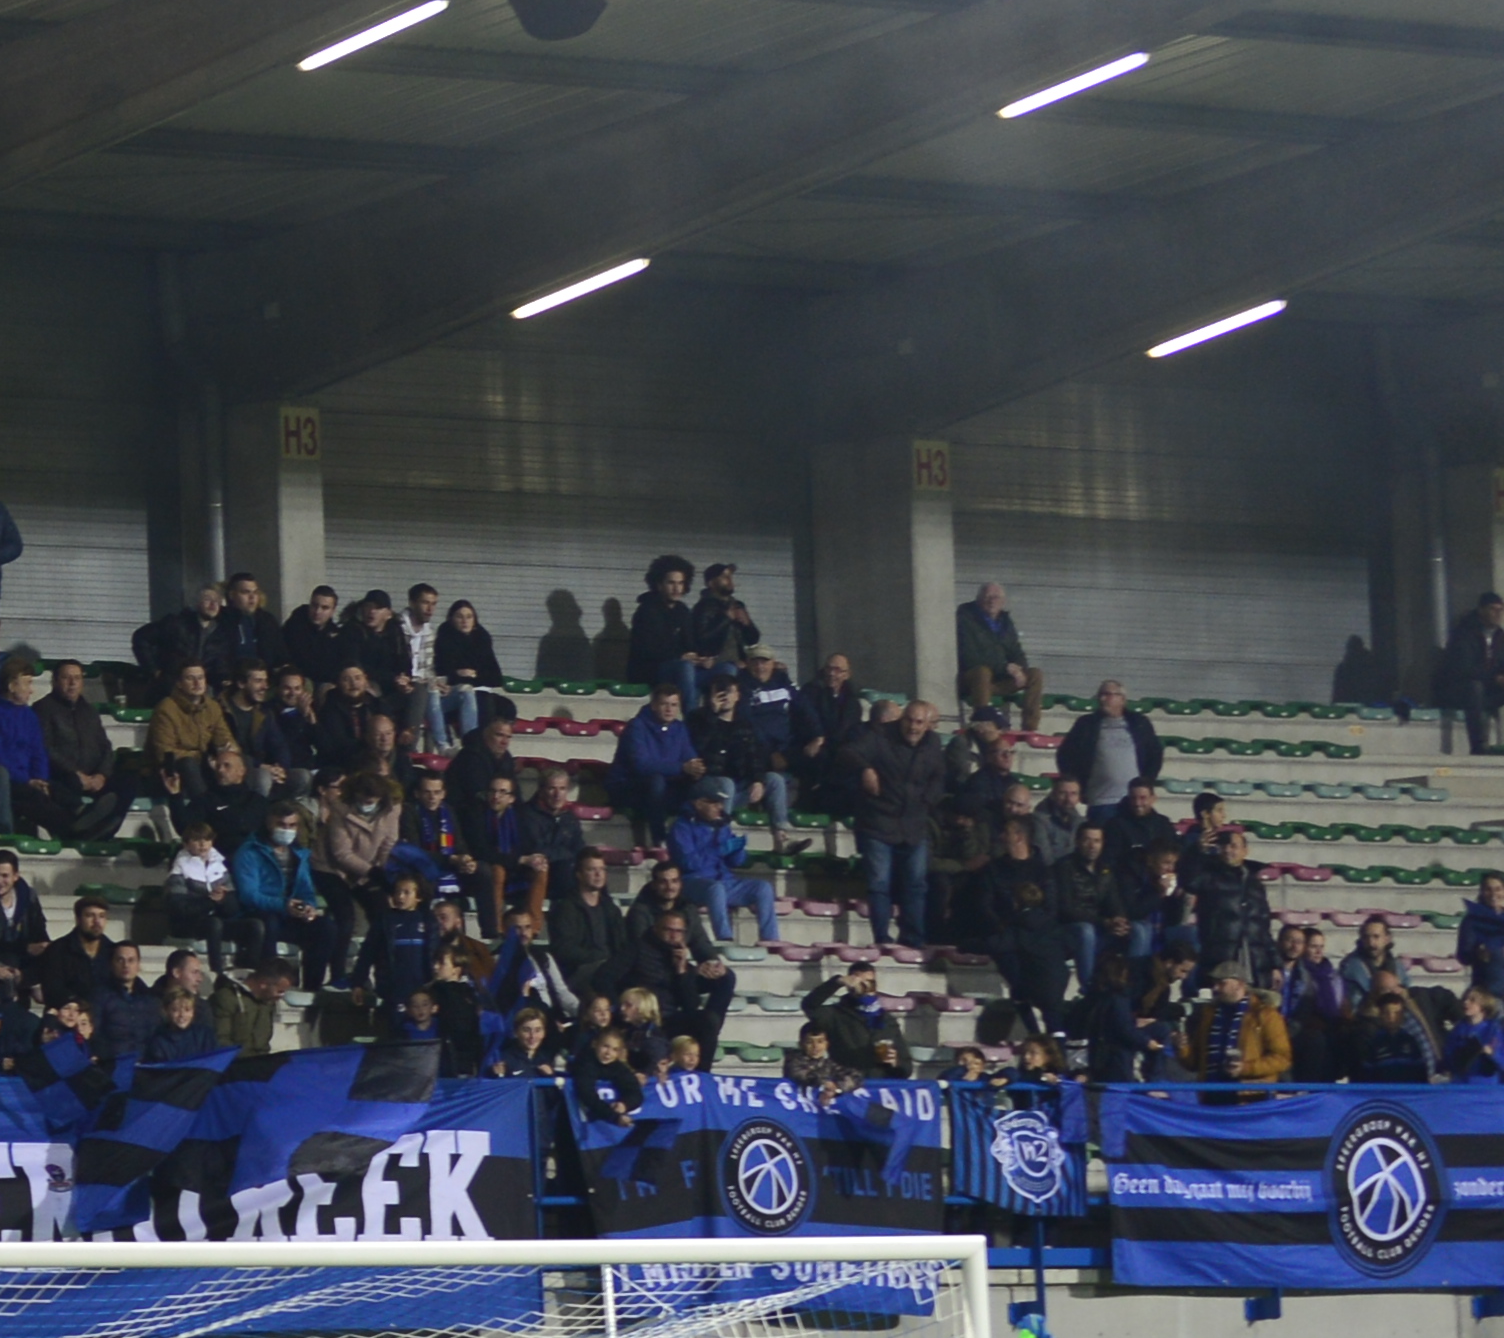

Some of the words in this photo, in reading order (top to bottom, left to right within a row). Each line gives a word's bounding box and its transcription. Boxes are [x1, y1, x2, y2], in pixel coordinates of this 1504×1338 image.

[283, 417, 318, 456] H3
[915, 448, 947, 487] H3
[900, 1170, 934, 1202] DIE
[1113, 1172, 1160, 1194] Geen
